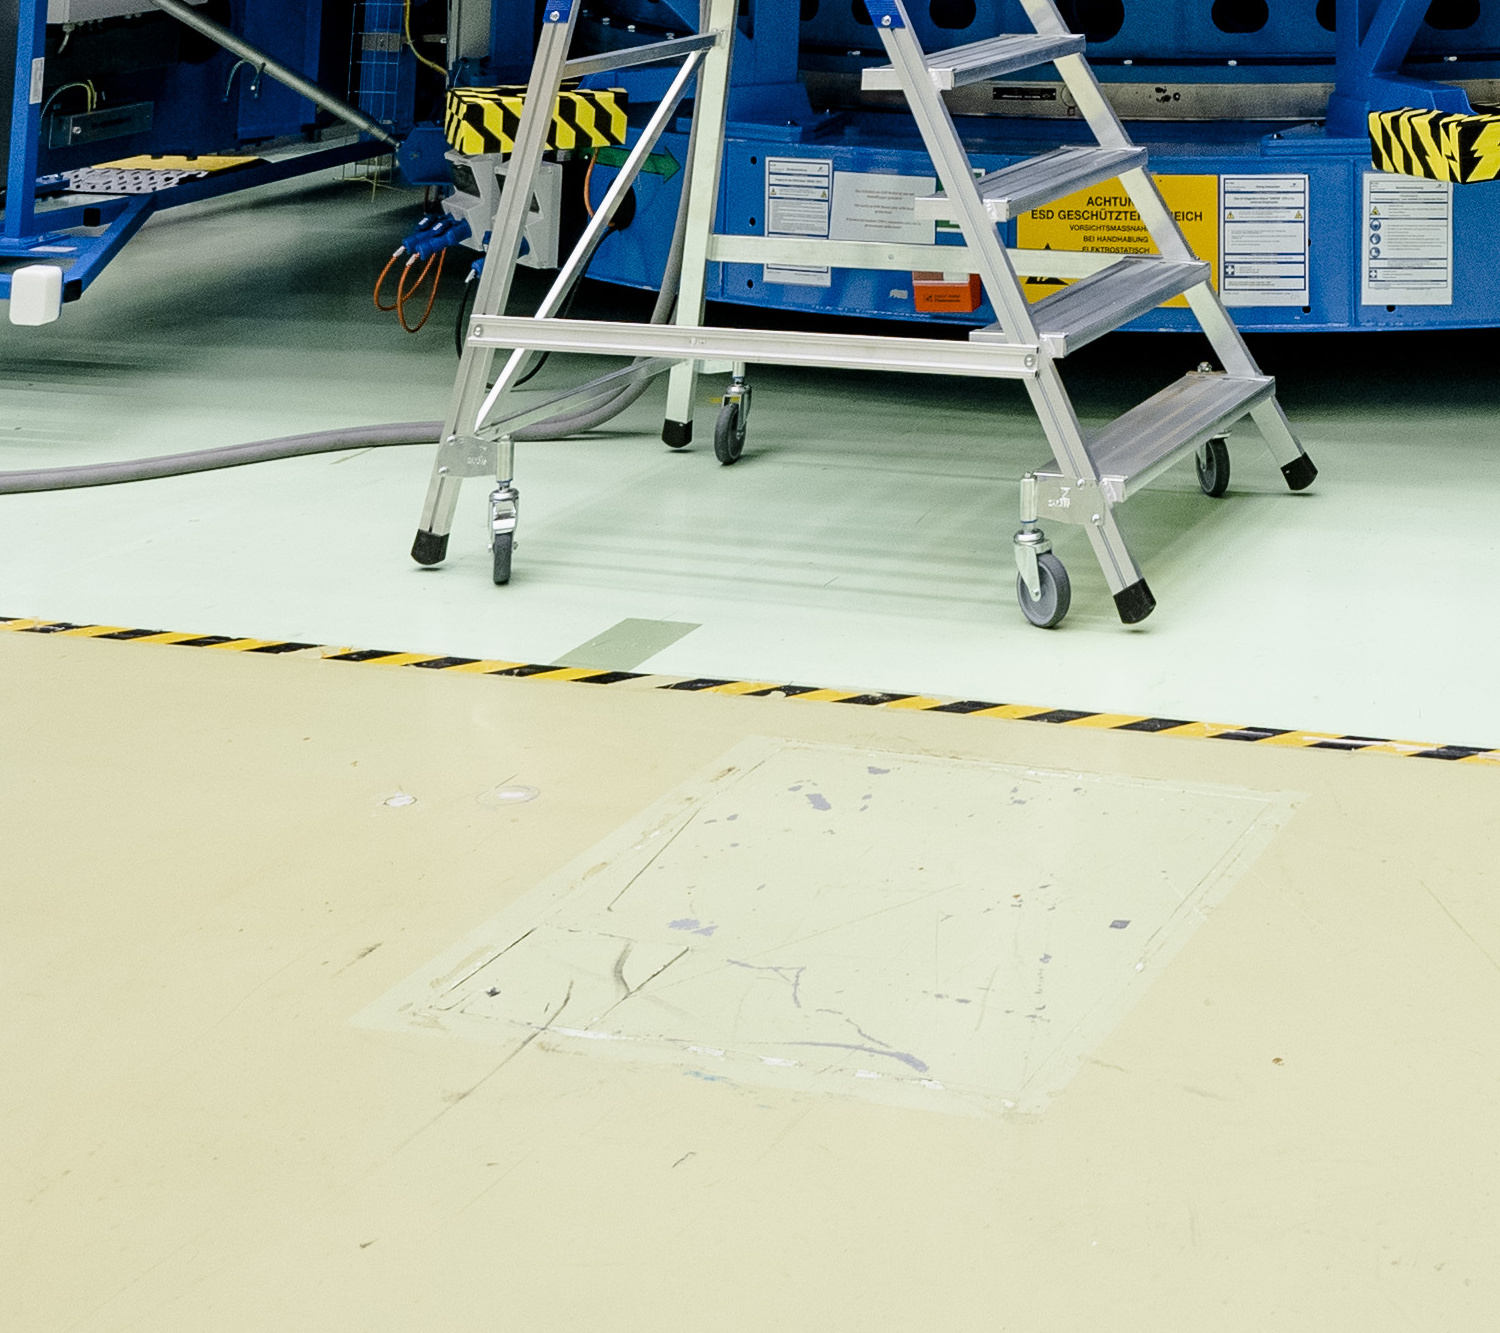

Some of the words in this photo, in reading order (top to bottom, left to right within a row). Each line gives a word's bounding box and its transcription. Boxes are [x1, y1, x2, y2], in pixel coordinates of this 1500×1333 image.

[1086, 196, 1135, 207] ACHTUN
[1031, 210, 1055, 220] ESD
[1083, 235, 1096, 243] BEI
[1096, 235, 1149, 243] HANDHABUNG
